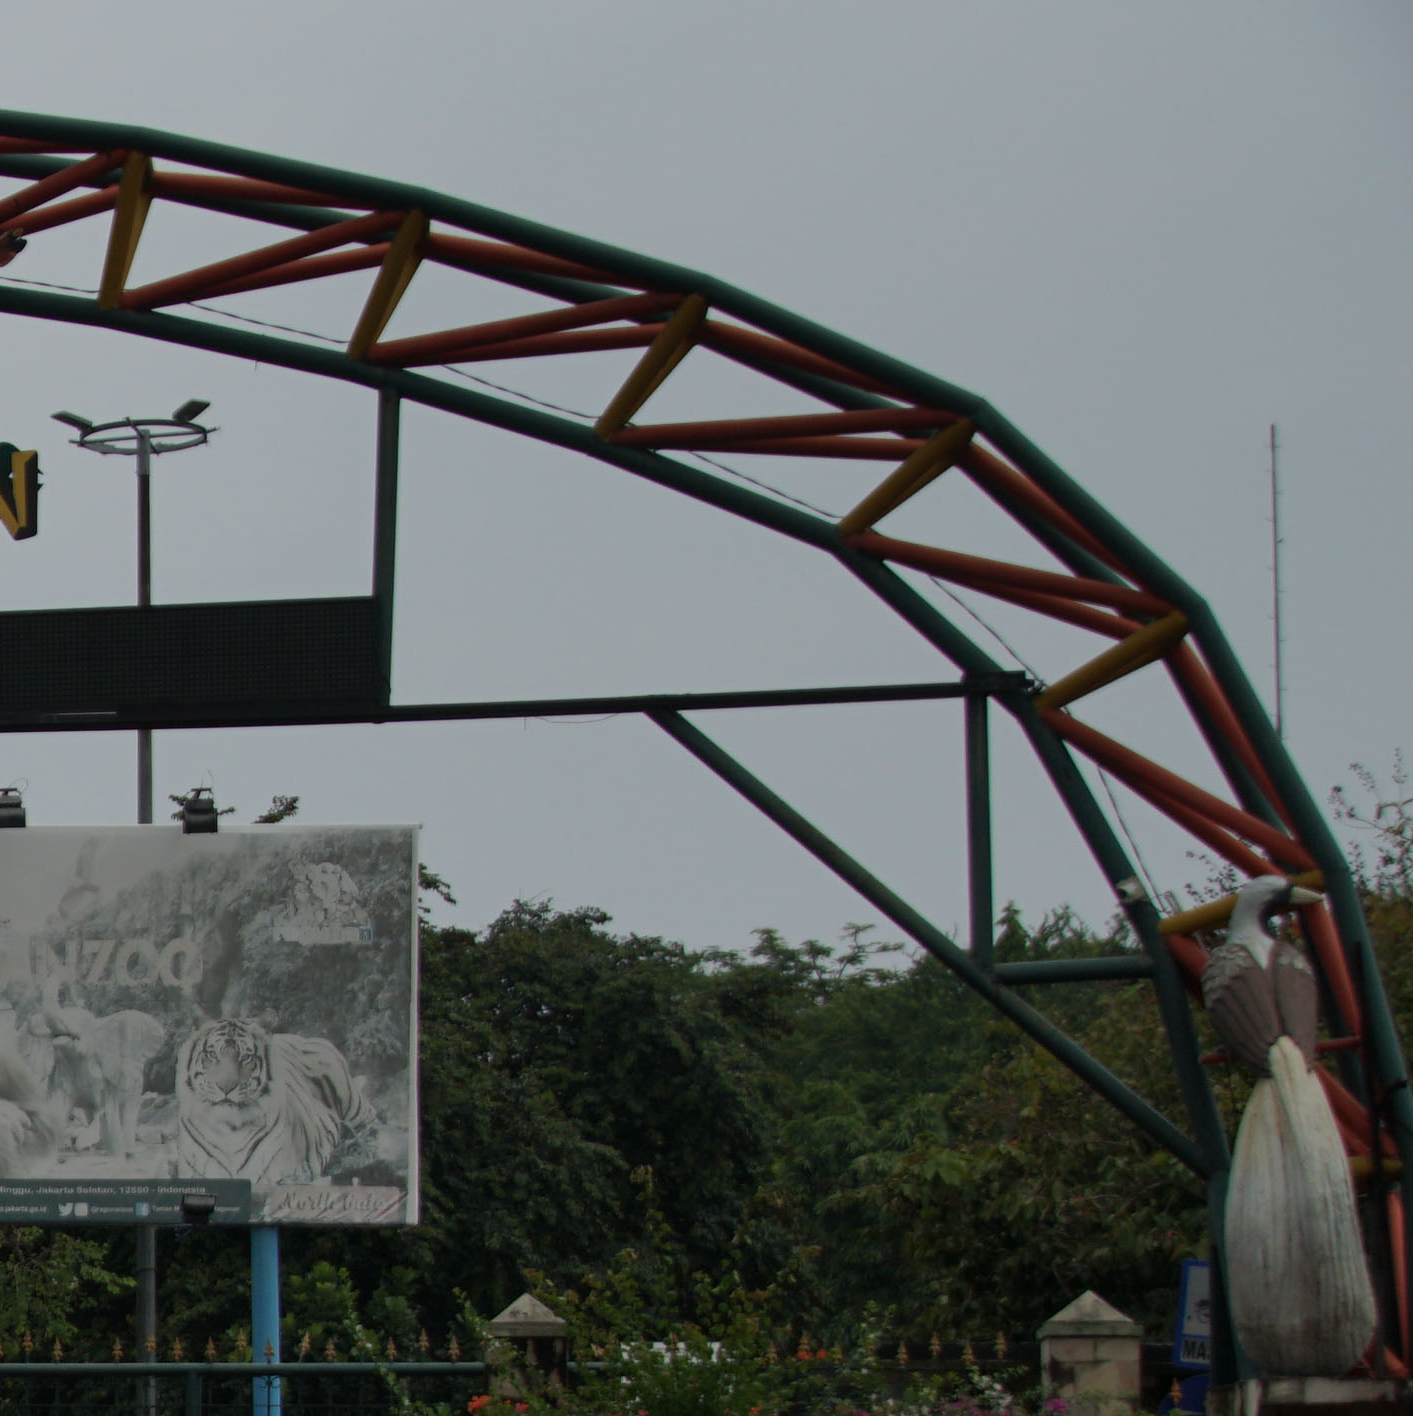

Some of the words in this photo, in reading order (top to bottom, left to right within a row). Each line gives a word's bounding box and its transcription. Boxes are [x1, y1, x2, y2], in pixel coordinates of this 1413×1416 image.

[36, 1186, 73, 1194] Jakarta
[157, 1186, 205, 1194] Indonesia
[1182, 1339, 1211, 1361] MA
